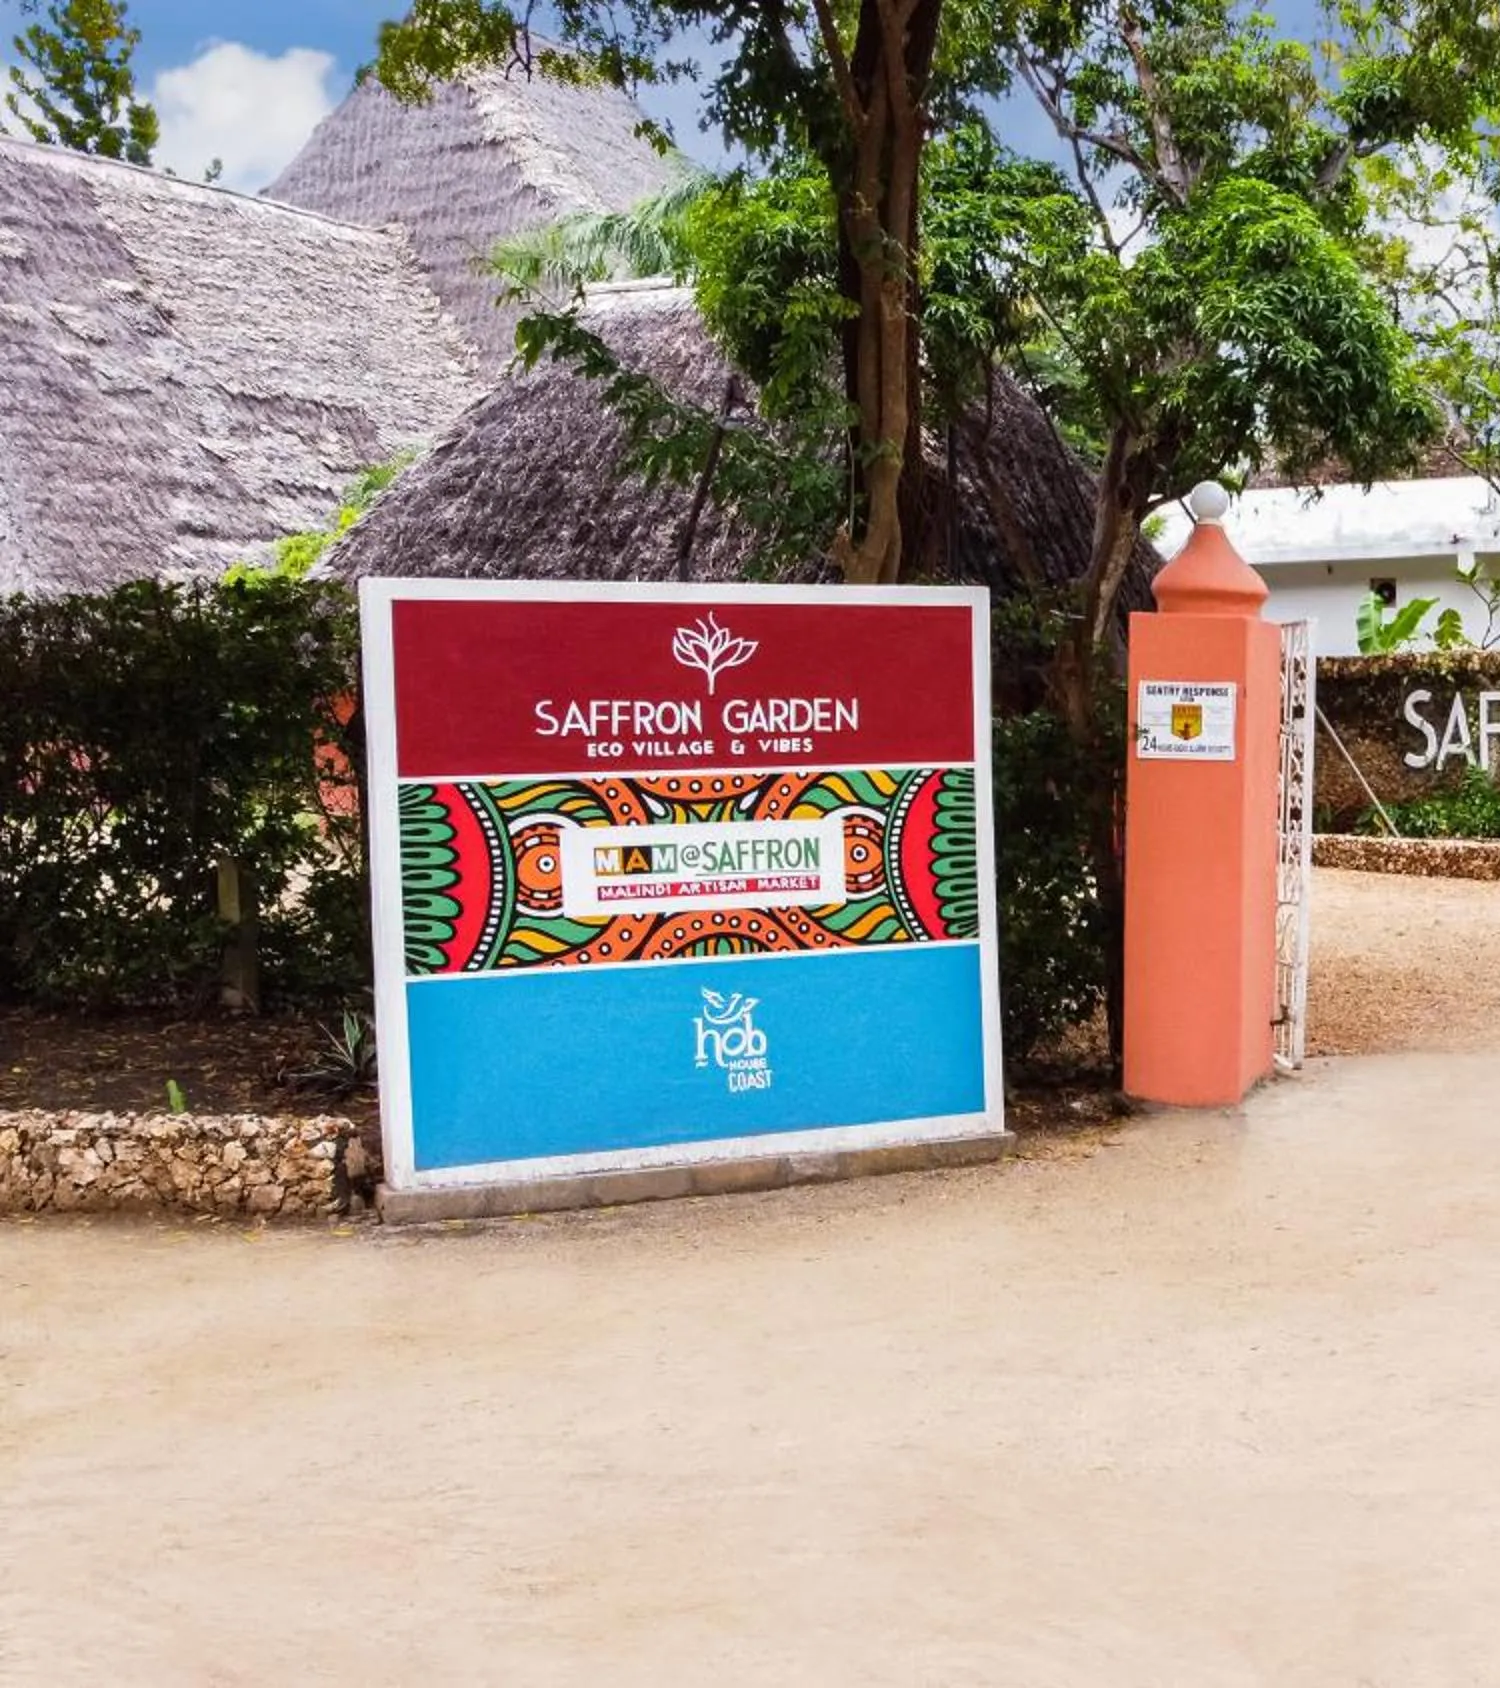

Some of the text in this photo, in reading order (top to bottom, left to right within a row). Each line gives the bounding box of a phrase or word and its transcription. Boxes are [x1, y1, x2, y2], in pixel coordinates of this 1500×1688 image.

[535, 697, 860, 737] SAFFRON GARDEN
[587, 737, 814, 757] ECO VILLAGE & VIBES
[1142, 735, 1157, 752] 24
[600, 876, 818, 900] MALINDI ARTISAN MARKET
[693, 1012, 767, 1069] hob
[729, 1058, 767, 1070] HOUSE
[728, 1070, 773, 1092] COAST
